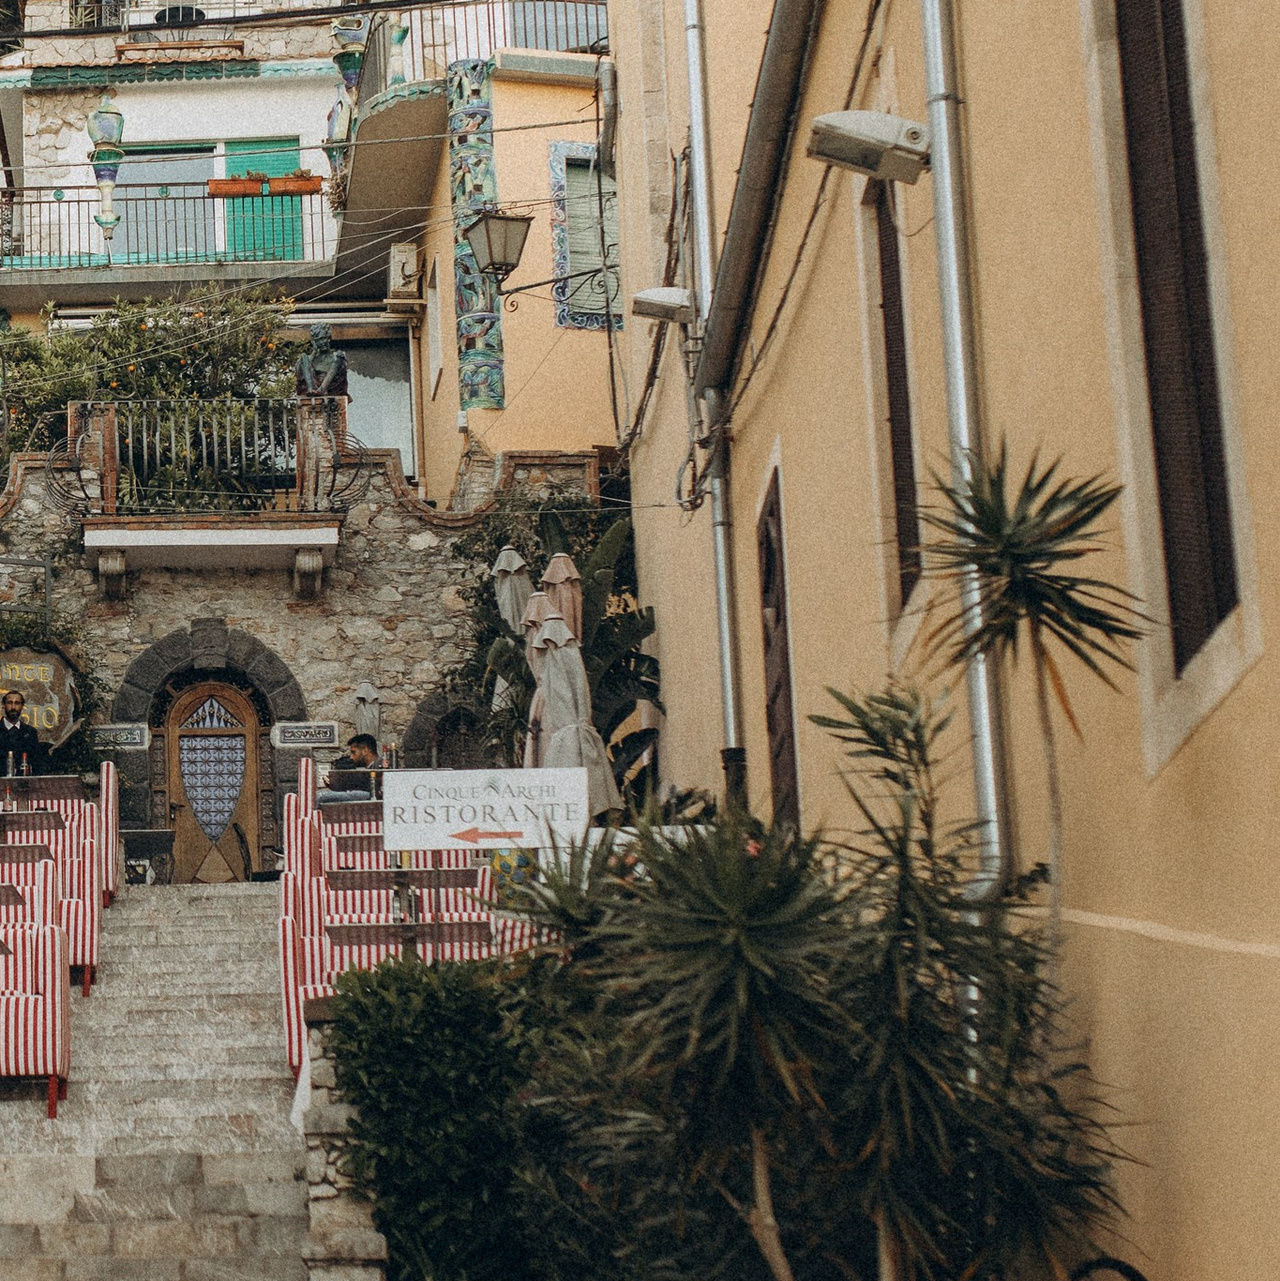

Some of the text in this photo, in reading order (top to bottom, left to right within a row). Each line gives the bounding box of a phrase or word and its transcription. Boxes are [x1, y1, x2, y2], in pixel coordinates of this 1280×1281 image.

[412, 783, 557, 802] CINQUE ARCHI
[392, 802, 579, 826] RISTORANTE
